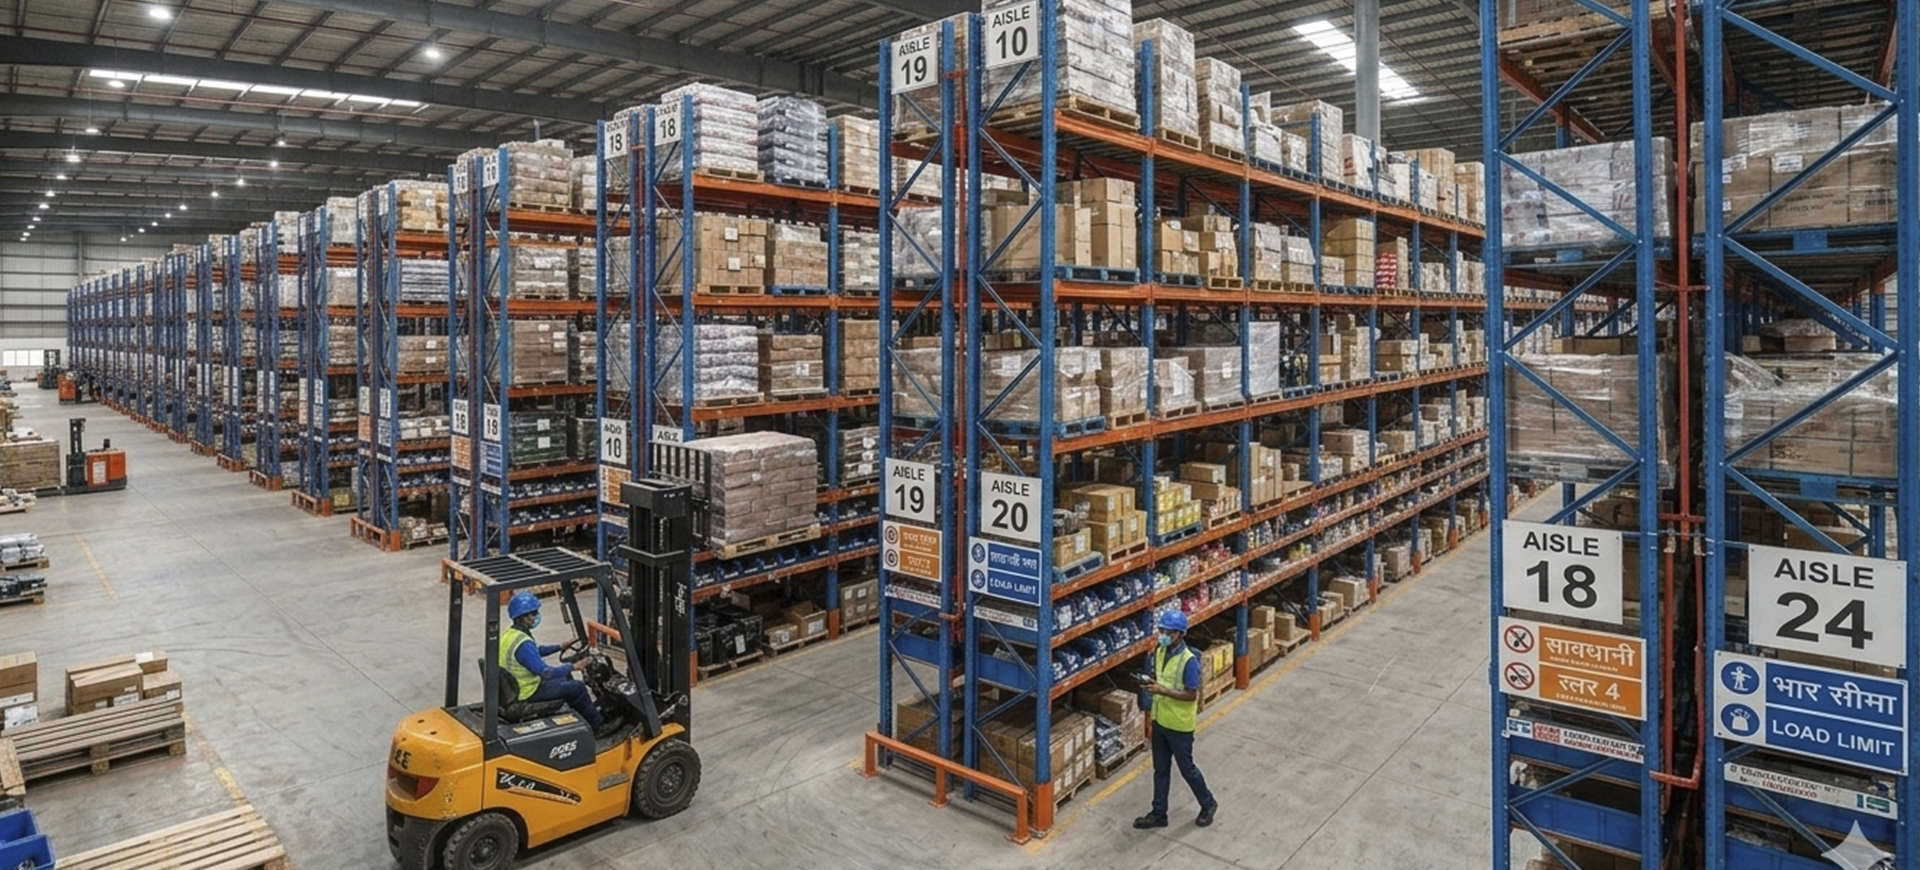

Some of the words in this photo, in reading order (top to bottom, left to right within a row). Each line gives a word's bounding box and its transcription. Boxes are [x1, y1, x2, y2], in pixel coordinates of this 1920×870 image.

[992, 5, 1030, 28] AISLE
[996, 26, 1028, 59] 10
[901, 55, 927, 85] 19
[660, 118, 677, 139] 18
[895, 484, 925, 514] 19
[991, 479, 1030, 497] AISLE
[991, 499, 1029, 533] 20
[1522, 531, 1600, 557] AISLE
[1526, 560, 1598, 609] 18
[1773, 558, 1875, 590] AISLE
[1776, 591, 1874, 650] 24
[1604, 682, 1621, 701] 4
[1772, 676, 1822, 702] भार
[1828, 681, 1898, 716] सीमा
[1772, 719, 1830, 744] LOAD
[1837, 732, 1895, 756] LIMIT
